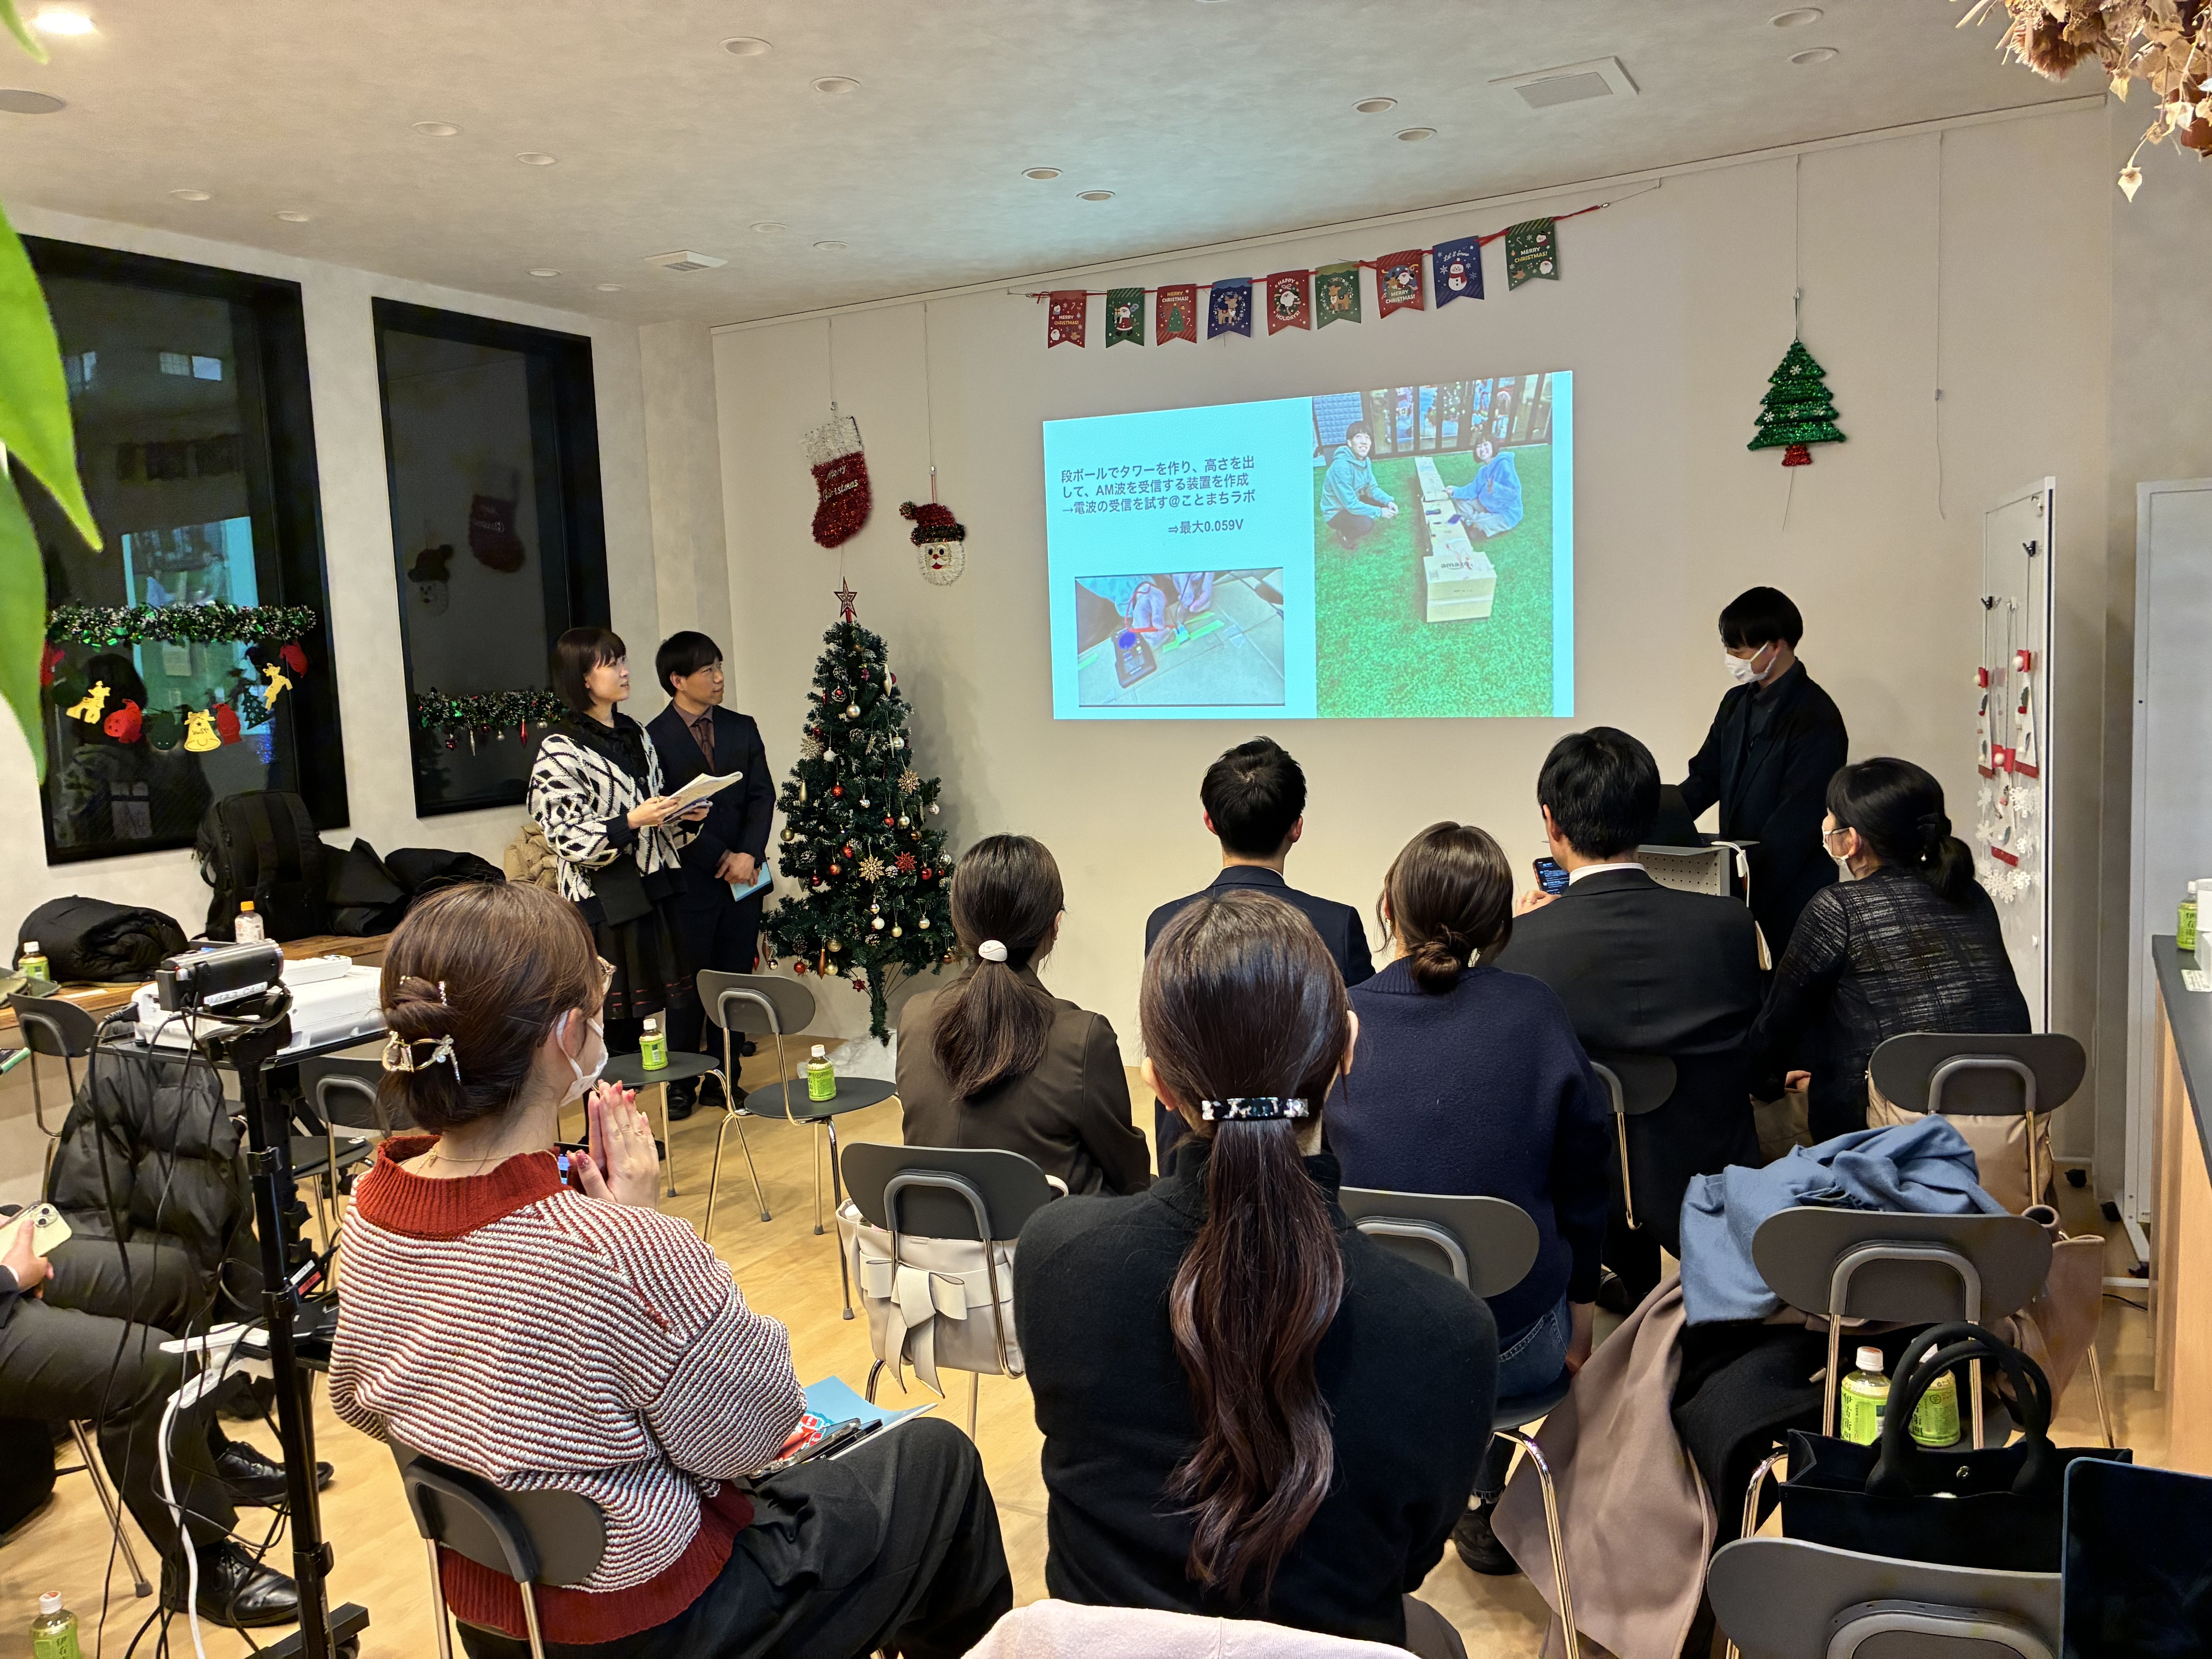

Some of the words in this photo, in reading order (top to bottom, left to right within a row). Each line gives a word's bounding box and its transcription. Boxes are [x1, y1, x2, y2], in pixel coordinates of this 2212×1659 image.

[1521, 247, 1540, 255] MERRY
[1515, 251, 1547, 263] CHRISTMAS!
[1386, 294, 1415, 304] CHRISTMAS!
[1275, 310, 1300, 321] HOLIDAYS!
[1061, 455, 1254, 483] 段ボールでタワーを作り、高さを出
[1063, 472, 1249, 498] して、AM波を受信する装置を作成
